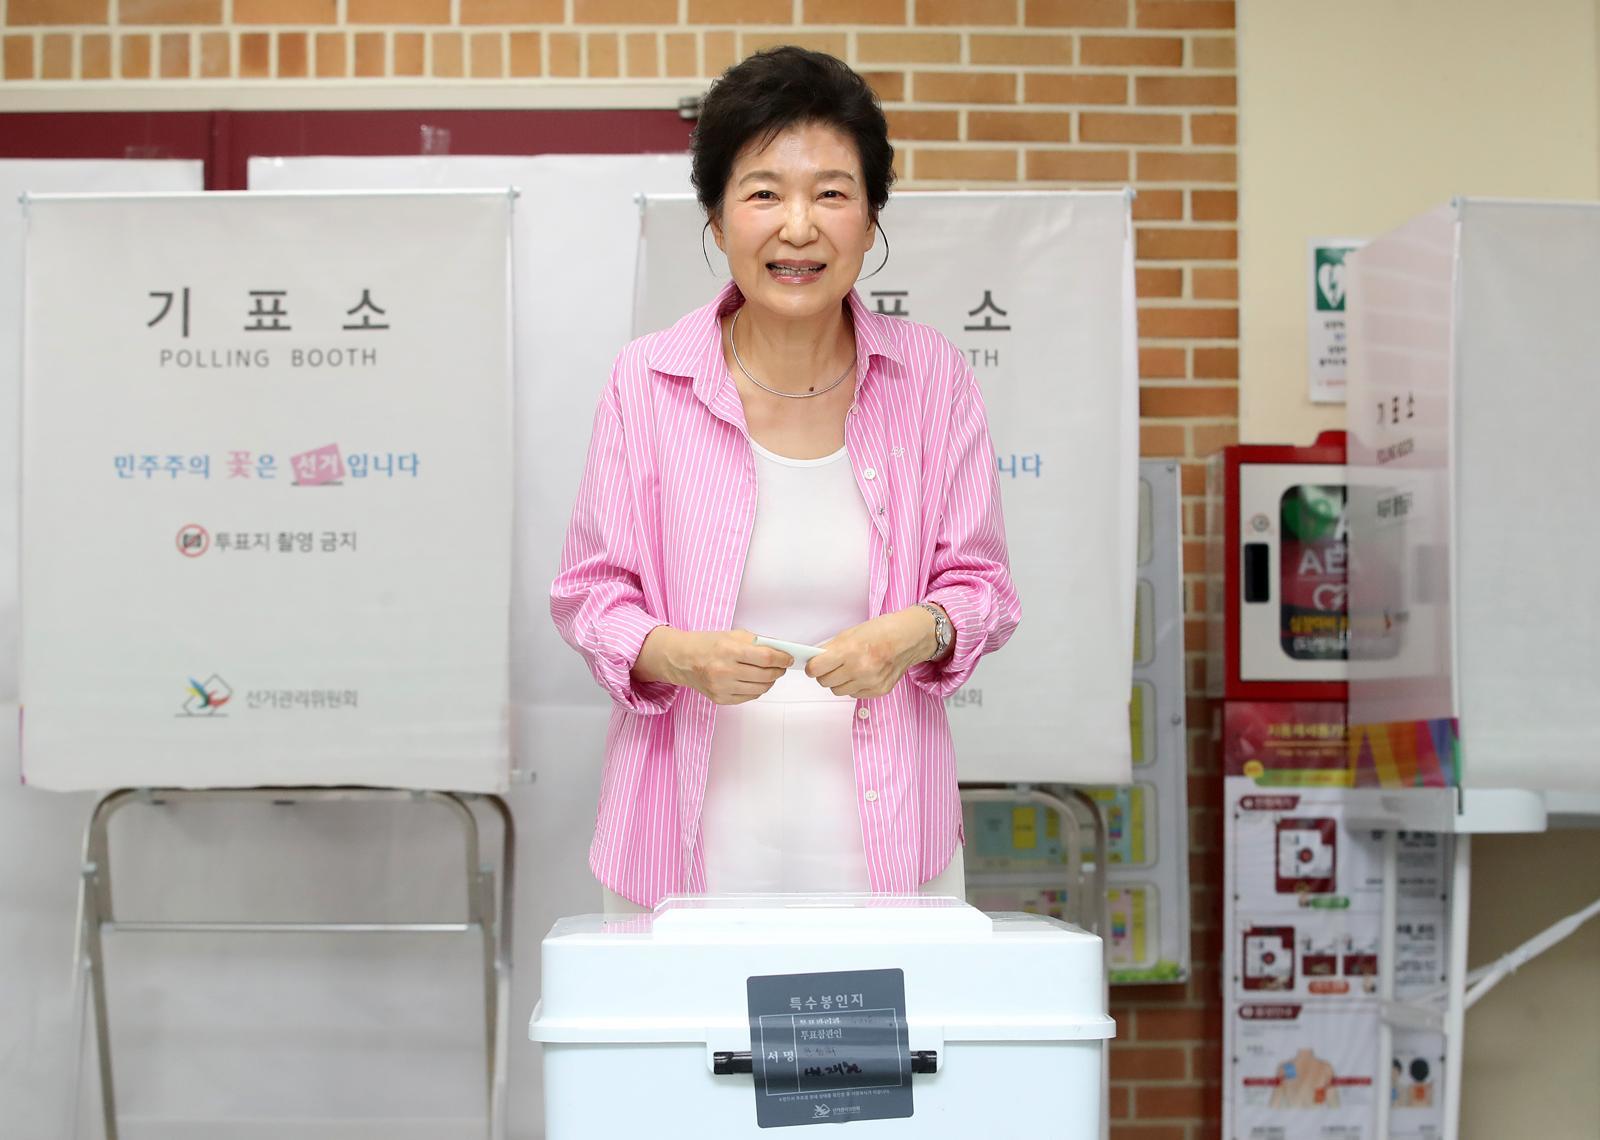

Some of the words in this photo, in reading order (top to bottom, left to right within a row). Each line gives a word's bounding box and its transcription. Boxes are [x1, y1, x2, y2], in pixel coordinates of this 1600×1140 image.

[962, 290, 1012, 333] 소
[160, 349, 270, 368] POLLING
[291, 348, 377, 368] BOOTH
[960, 348, 999, 367] TH
[113, 454, 211, 479] 민주주의
[226, 450, 278, 479] 꽃은
[214, 532, 271, 552] 투표지
[277, 532, 314, 552] 촬영
[320, 531, 358, 552] 금지
[246, 689, 359, 709] 선거관리위원회
[789, 993, 864, 1011] 특수봉인지
